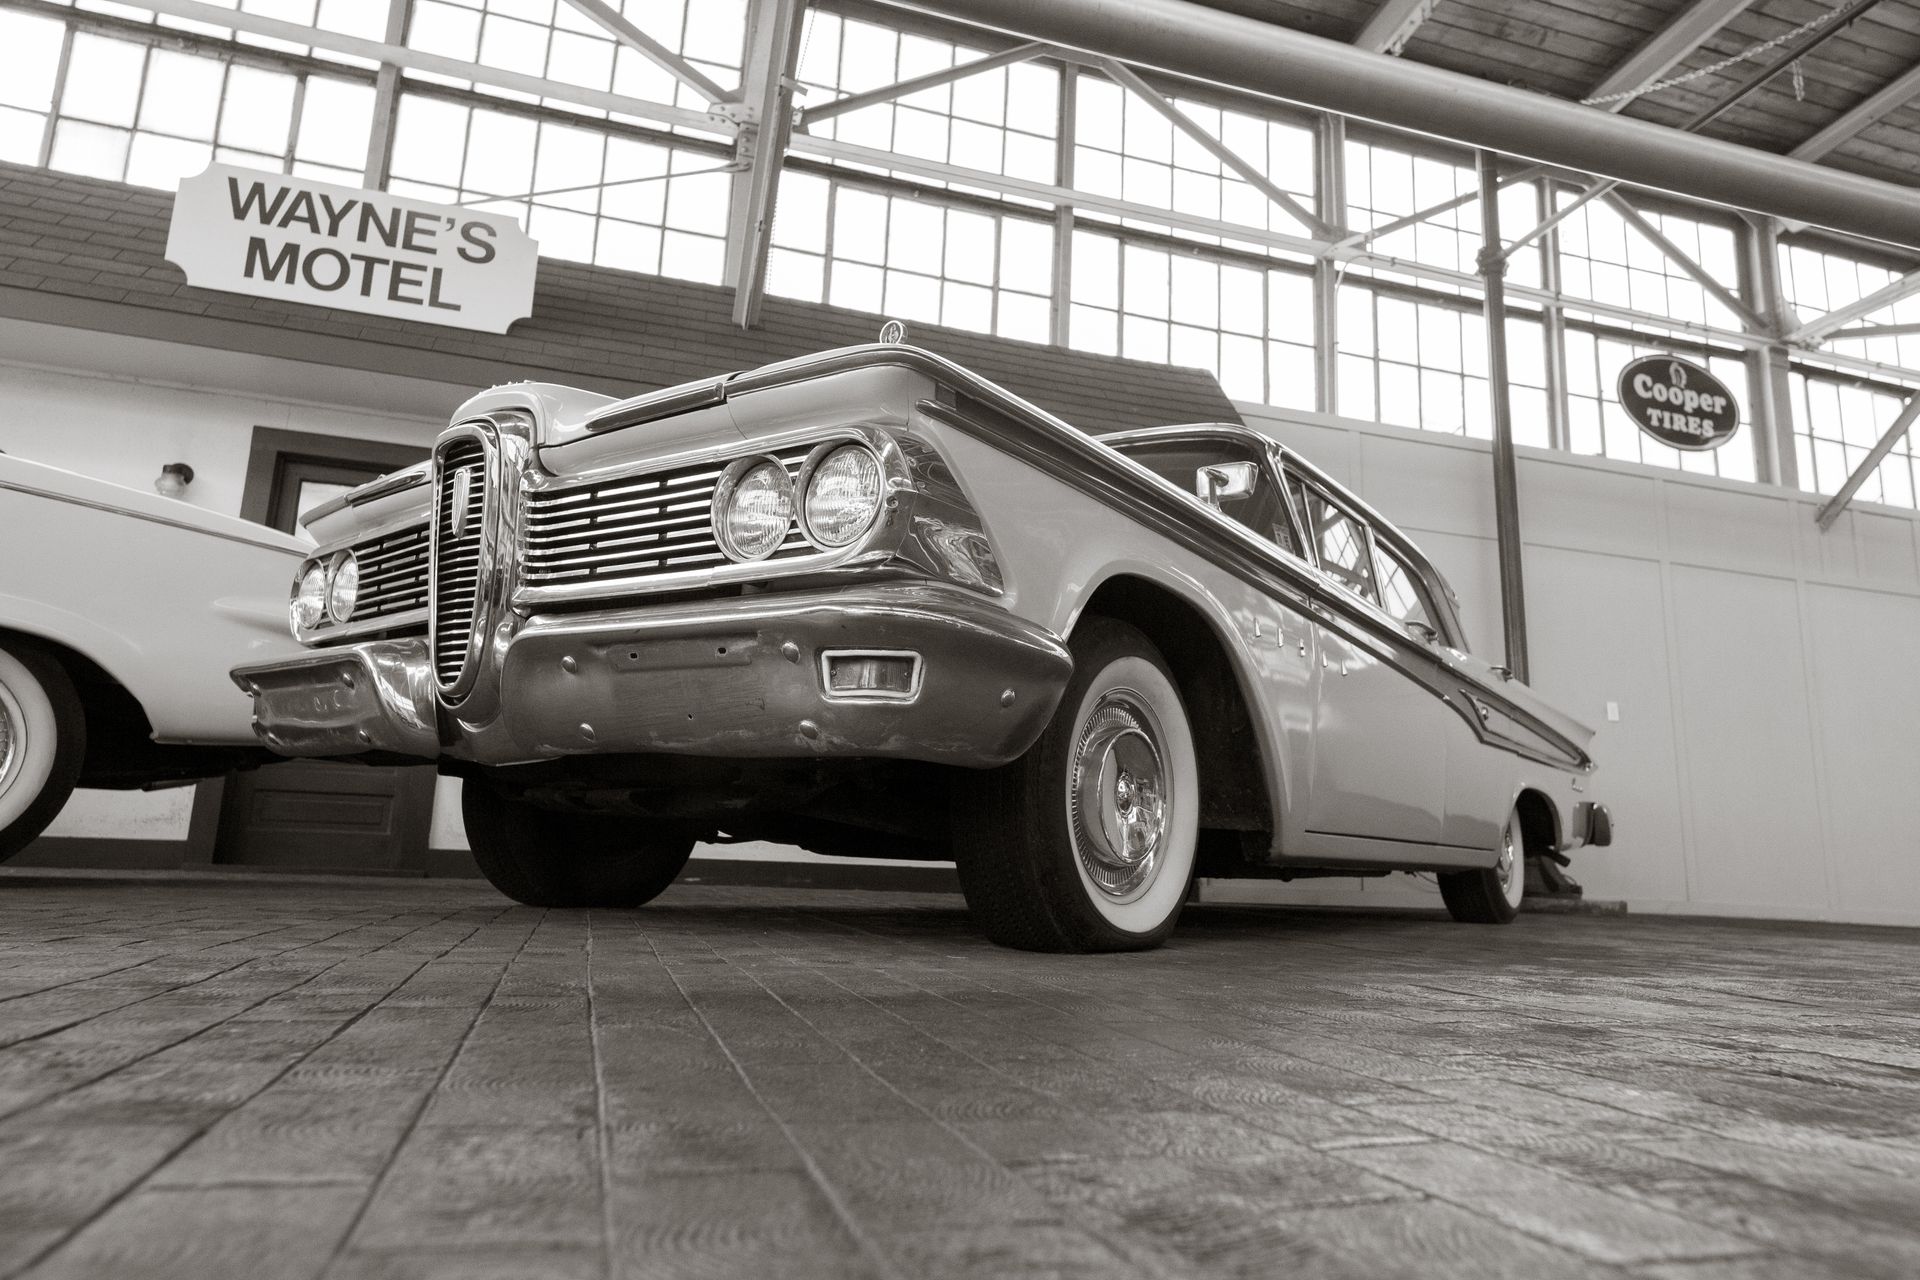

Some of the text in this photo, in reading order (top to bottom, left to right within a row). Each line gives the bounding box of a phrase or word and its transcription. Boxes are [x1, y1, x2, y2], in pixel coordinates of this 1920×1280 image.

[227, 176, 498, 264] WAYNE'S
[243, 236, 461, 311] MOTEL
[1633, 373, 1727, 415] Cooper
[1646, 407, 1715, 438] TIRES
